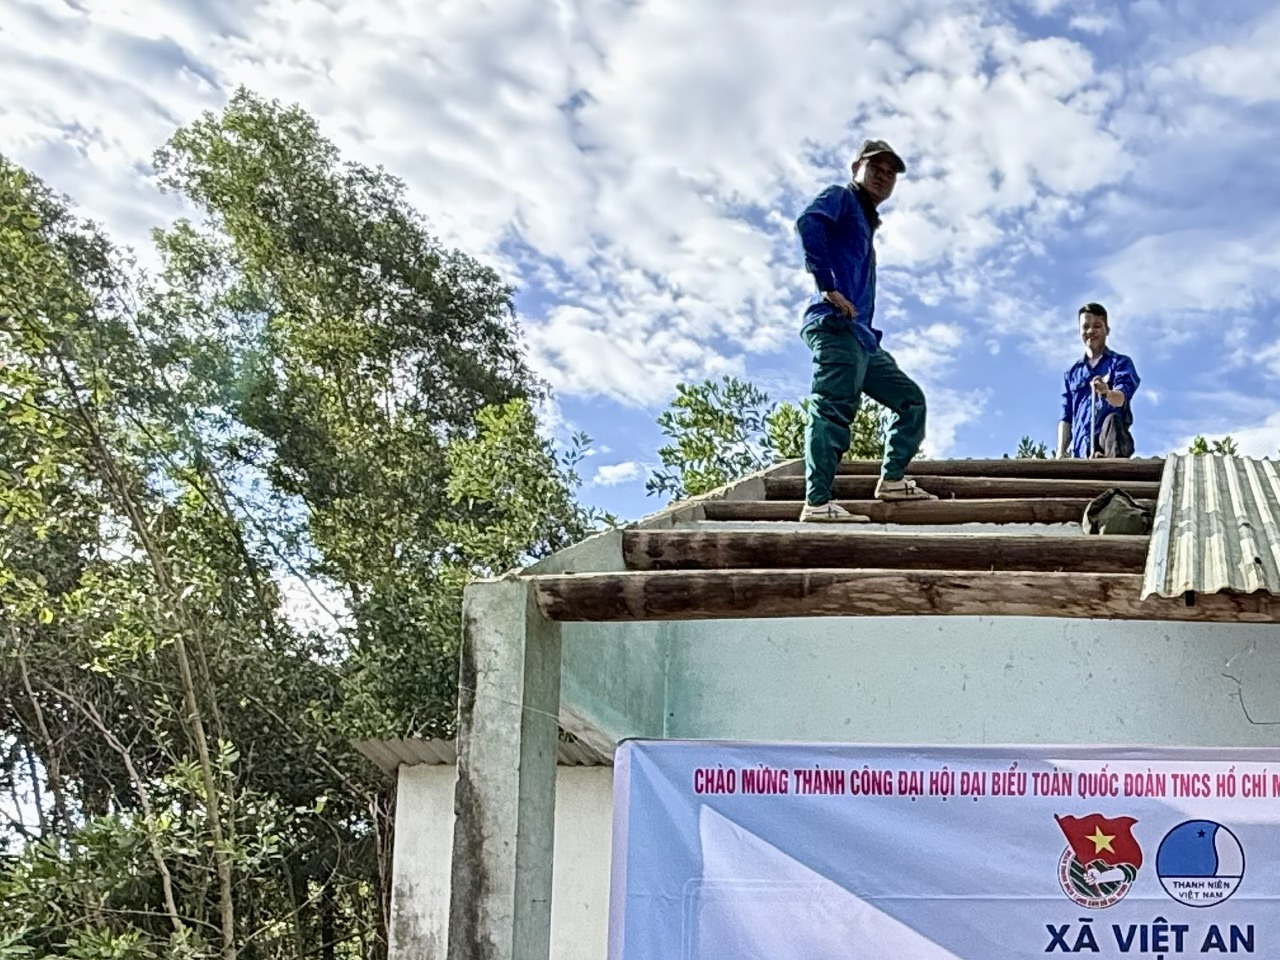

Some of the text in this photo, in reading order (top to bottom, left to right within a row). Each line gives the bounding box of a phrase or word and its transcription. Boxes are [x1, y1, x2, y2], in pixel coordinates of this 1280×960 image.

[694, 763, 736, 794] CHÀO
[741, 763, 788, 795] MỪNG
[793, 764, 845, 795] THÀNH
[850, 765, 893, 796] CÔNG
[898, 771, 924, 801] ĐẠI
[929, 766, 955, 801] HỘI
[960, 771, 987, 801] ĐẠI
[991, 761, 1027, 796] BIỂU
[1032, 767, 1072, 796] TOÀN
[1078, 764, 1119, 799] QUỐC
[1124, 768, 1166, 797] ĐOÀN
[1171, 773, 1211, 798] TNCS
[1216, 766, 1236, 798] HỒ
[1242, 769, 1267, 798] CHÍ
[1172, 879, 1230, 889] THANH NIÊN
[1178, 890, 1200, 900] VIỆT
[1045, 918, 1100, 952] XÃ
[1201, 925, 1254, 952] AN
